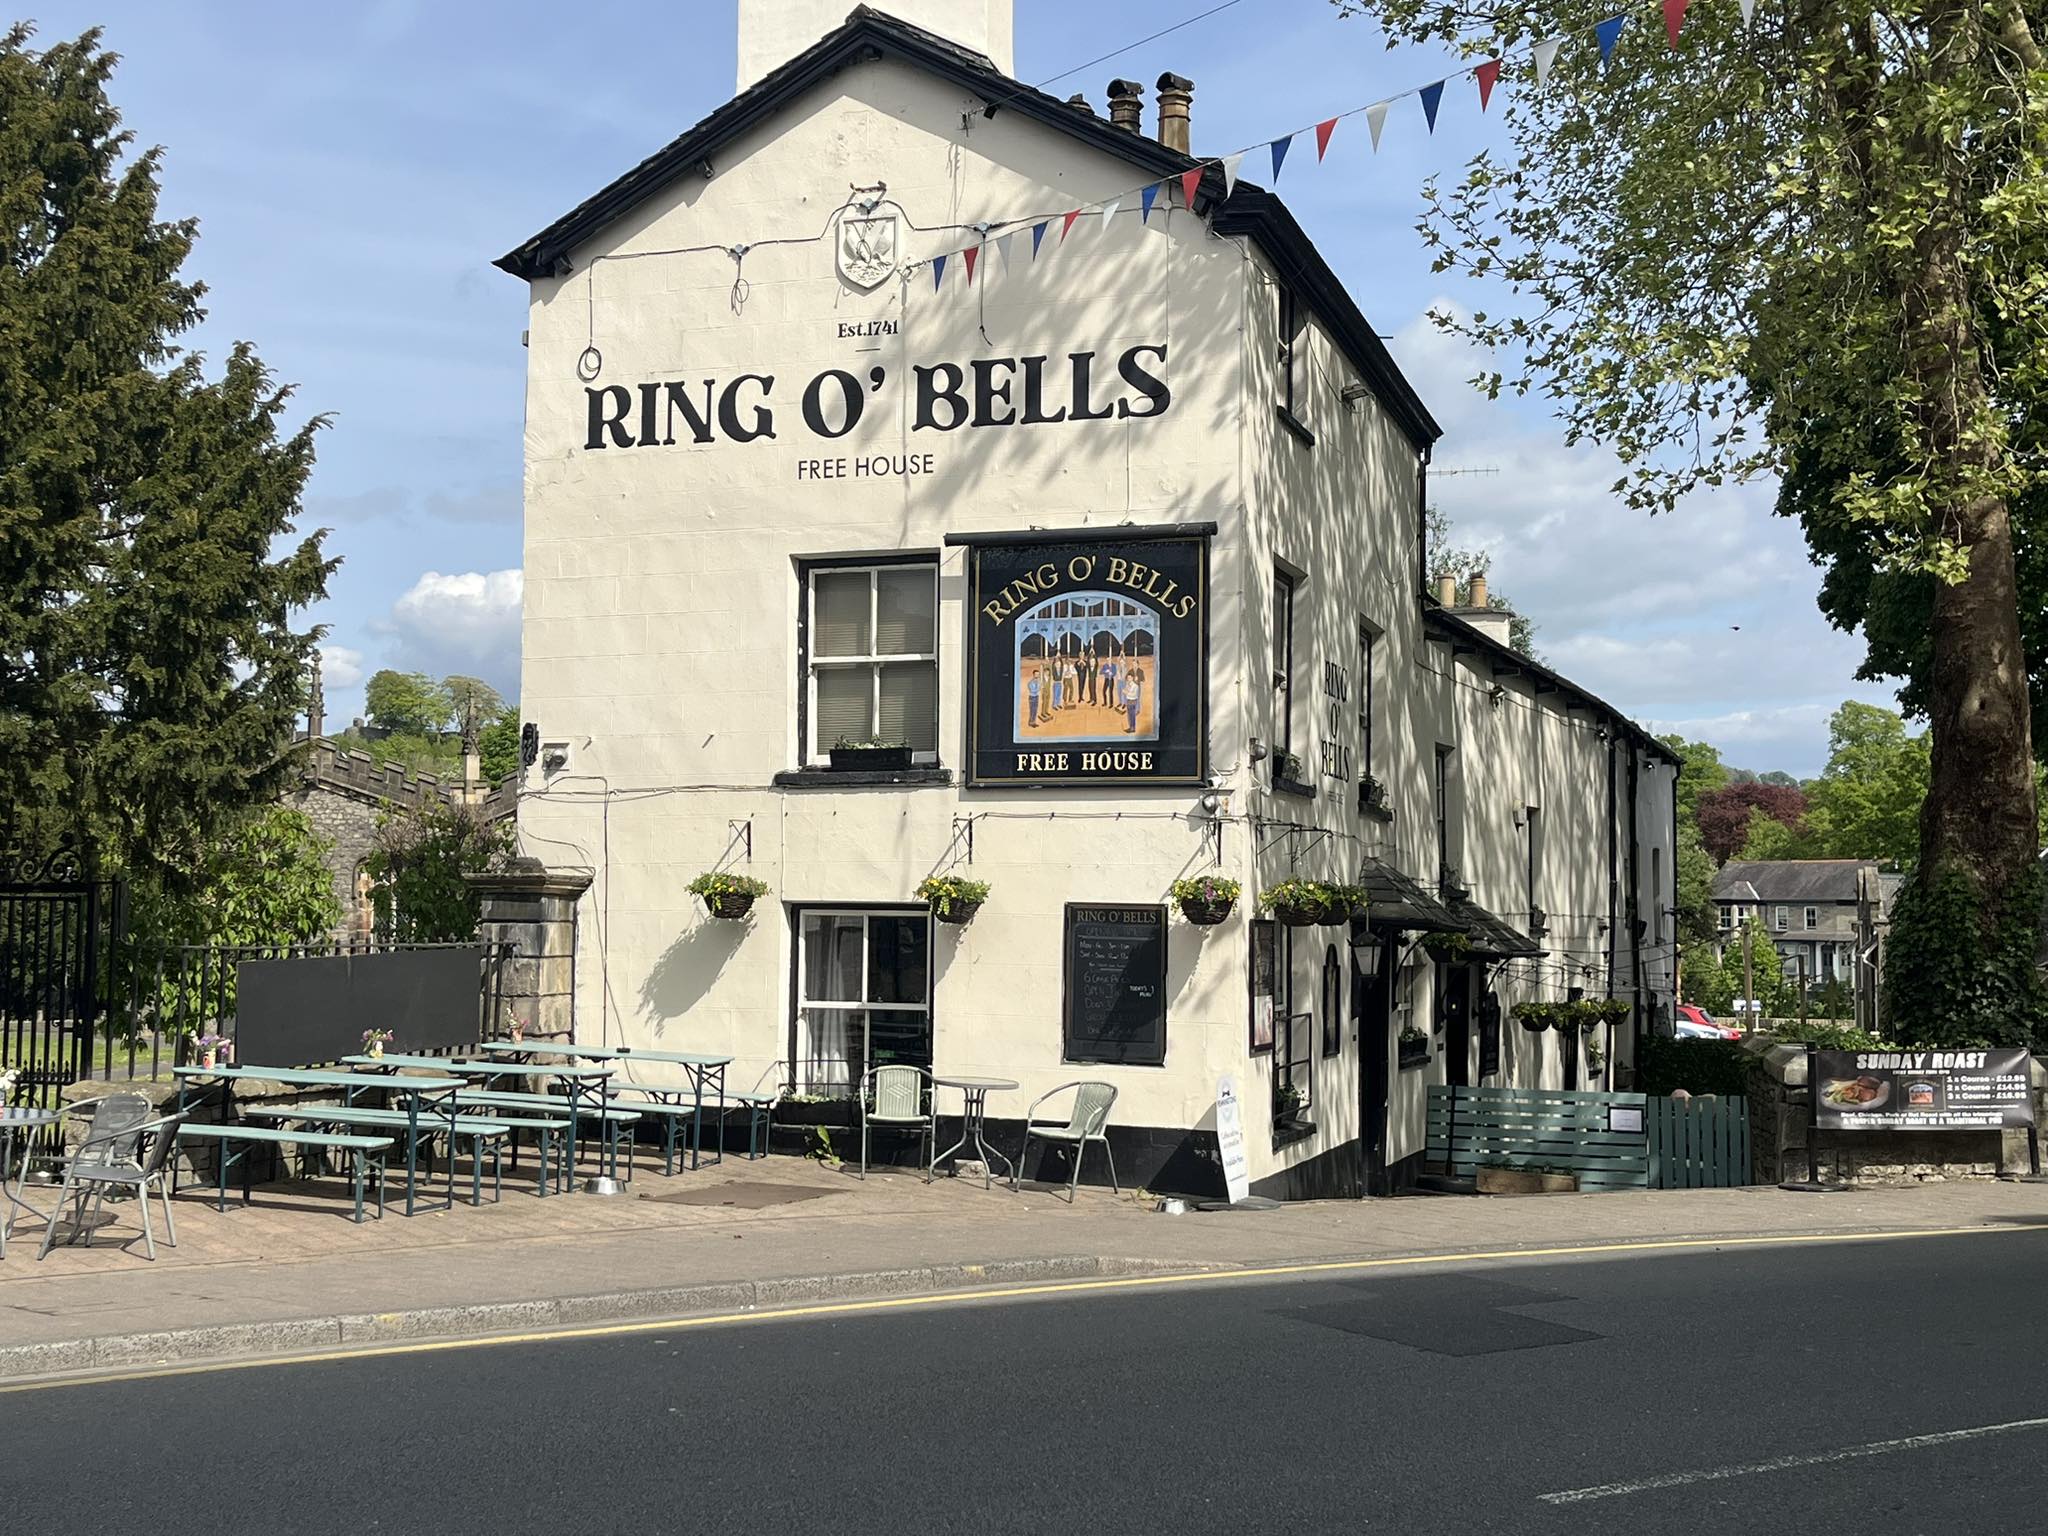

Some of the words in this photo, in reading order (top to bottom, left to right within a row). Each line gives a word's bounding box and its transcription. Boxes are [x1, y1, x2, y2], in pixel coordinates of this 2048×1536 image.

[837, 318, 900, 340] Est.1741
[583, 374, 777, 451] RING
[801, 366, 886, 439] O'
[912, 343, 1174, 432] BELLS
[797, 458, 846, 481] FREE
[855, 454, 935, 477] HOUSE
[982, 562, 1061, 627] RING
[1067, 555, 1098, 582] O'
[1106, 556, 1197, 619] BELLS
[1323, 660, 1348, 703] RING
[1015, 753, 1070, 772] FREE
[1081, 751, 1153, 771] HOUSE
[1320, 740, 1350, 783] BELLS
[1077, 910, 1106, 922] RING
[1108, 911, 1121, 922] O'
[1123, 911, 1157, 923] BELLS
[1856, 1053, 1926, 1069] SUNDAY
[1931, 1053, 1987, 1069] ROAST
[1961, 1092, 1991, 1100] Course
